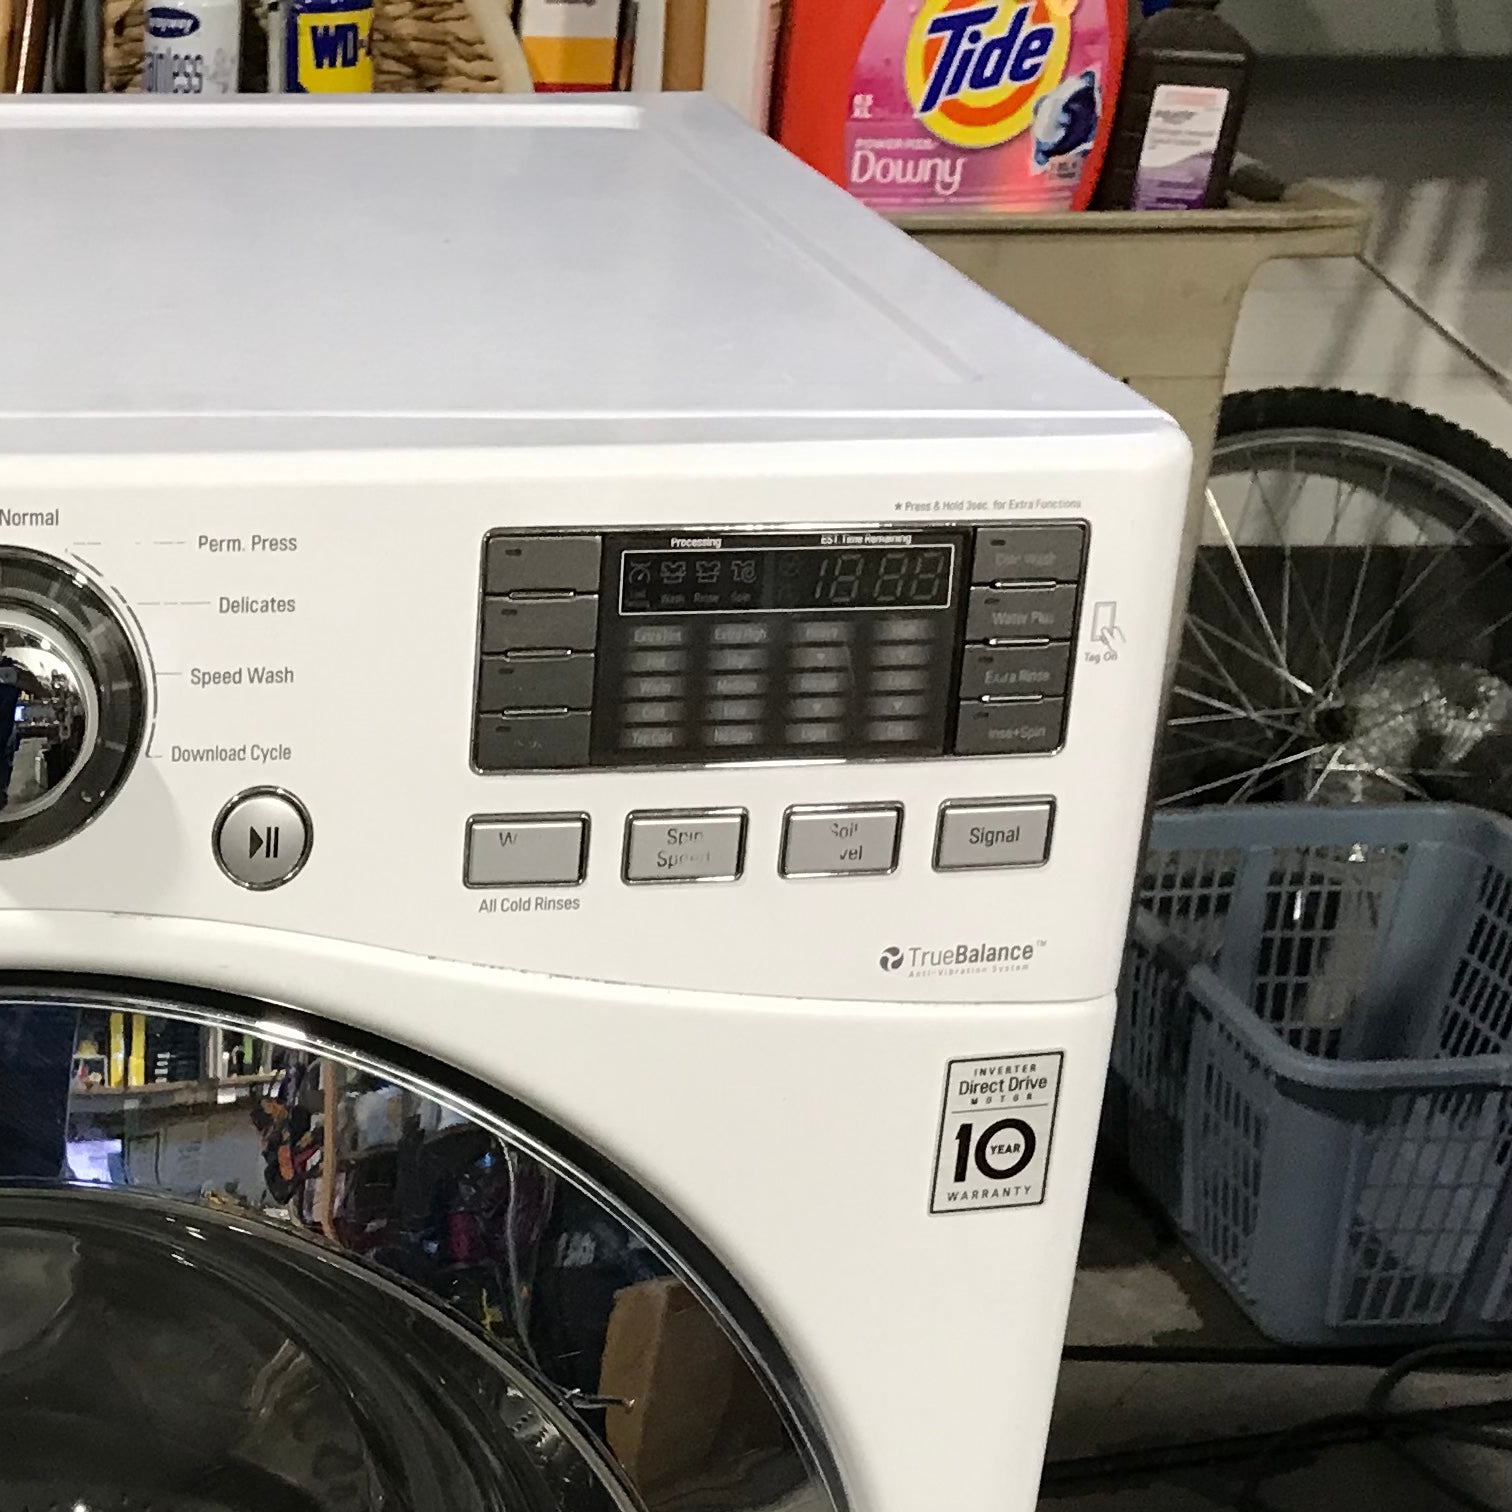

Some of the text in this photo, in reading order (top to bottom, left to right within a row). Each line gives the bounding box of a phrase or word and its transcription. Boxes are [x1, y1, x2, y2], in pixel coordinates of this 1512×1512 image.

[918, 5, 1055, 114] Tide
[851, 150, 968, 195] Downy
[993, 499, 1006, 510] for
[1009, 498, 1034, 509] Extra
[1036, 498, 1082, 509] Functions
[198, 534, 298, 552] Perm. Press
[670, 537, 723, 549] Processing
[218, 596, 296, 614] Delicates
[190, 666, 294, 688] Speed Wash
[171, 744, 292, 764] Download Cycle
[969, 827, 1020, 847] Signal
[479, 896, 581, 913] All Cold Rinses
[974, 1064, 1037, 1077] INVERTER
[959, 1076, 1049, 1096] Direct Drive
[971, 1093, 1033, 1105] MOTOR
[954, 1118, 1037, 1183] 10
[990, 1143, 1021, 1155] YEAR
[947, 1186, 1033, 1202] WARRANTY
